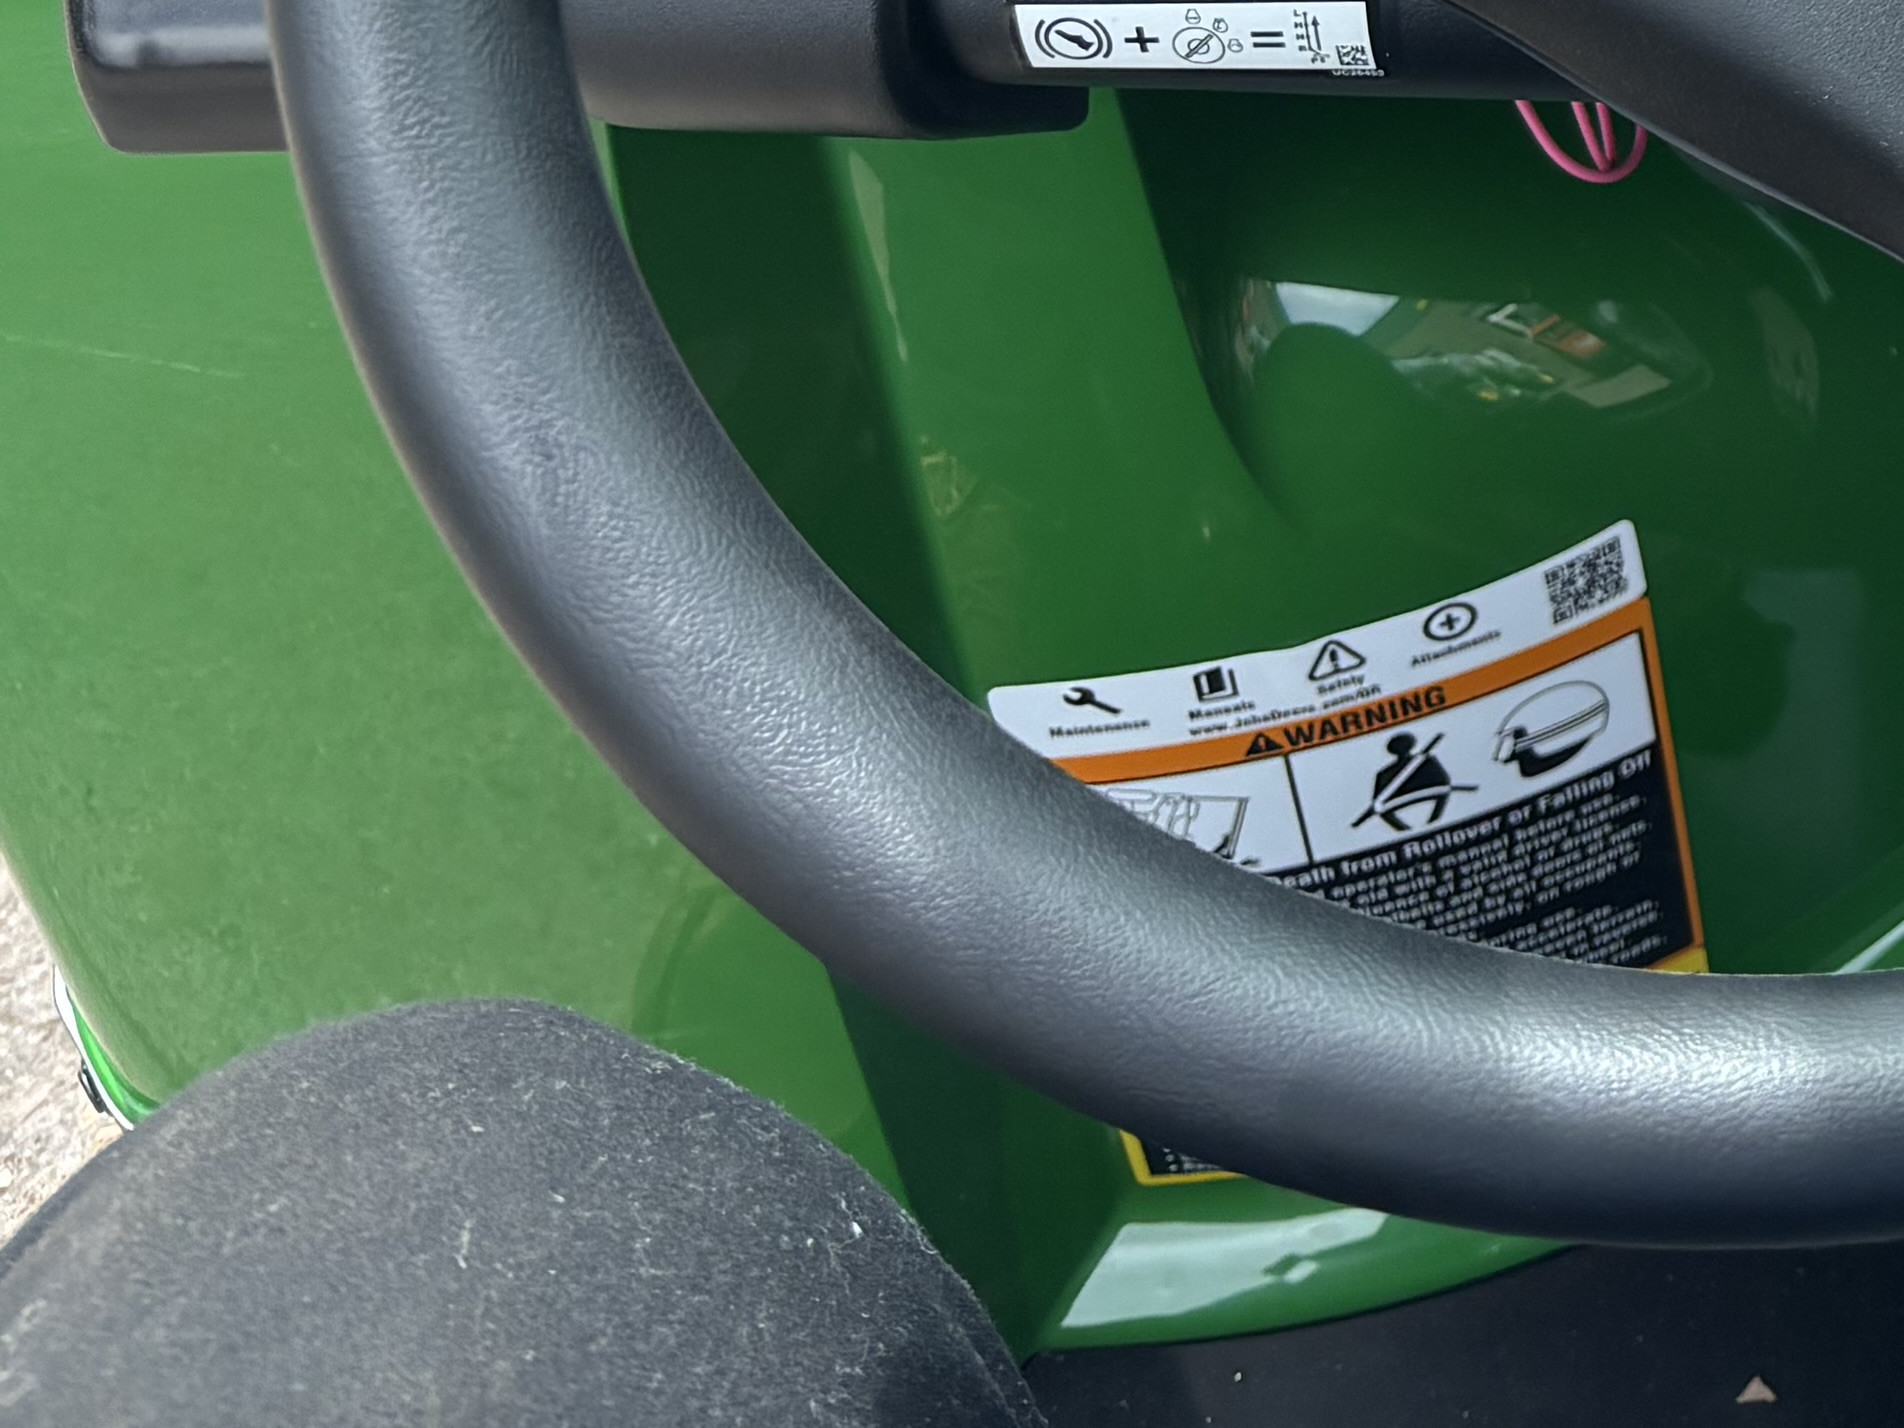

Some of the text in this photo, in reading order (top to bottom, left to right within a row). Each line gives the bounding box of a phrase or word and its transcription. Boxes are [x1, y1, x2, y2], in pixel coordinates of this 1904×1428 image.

[1283, 685, 1446, 748] WARNING
[1270, 750, 1651, 889] eath from Rollover or Falling Off
